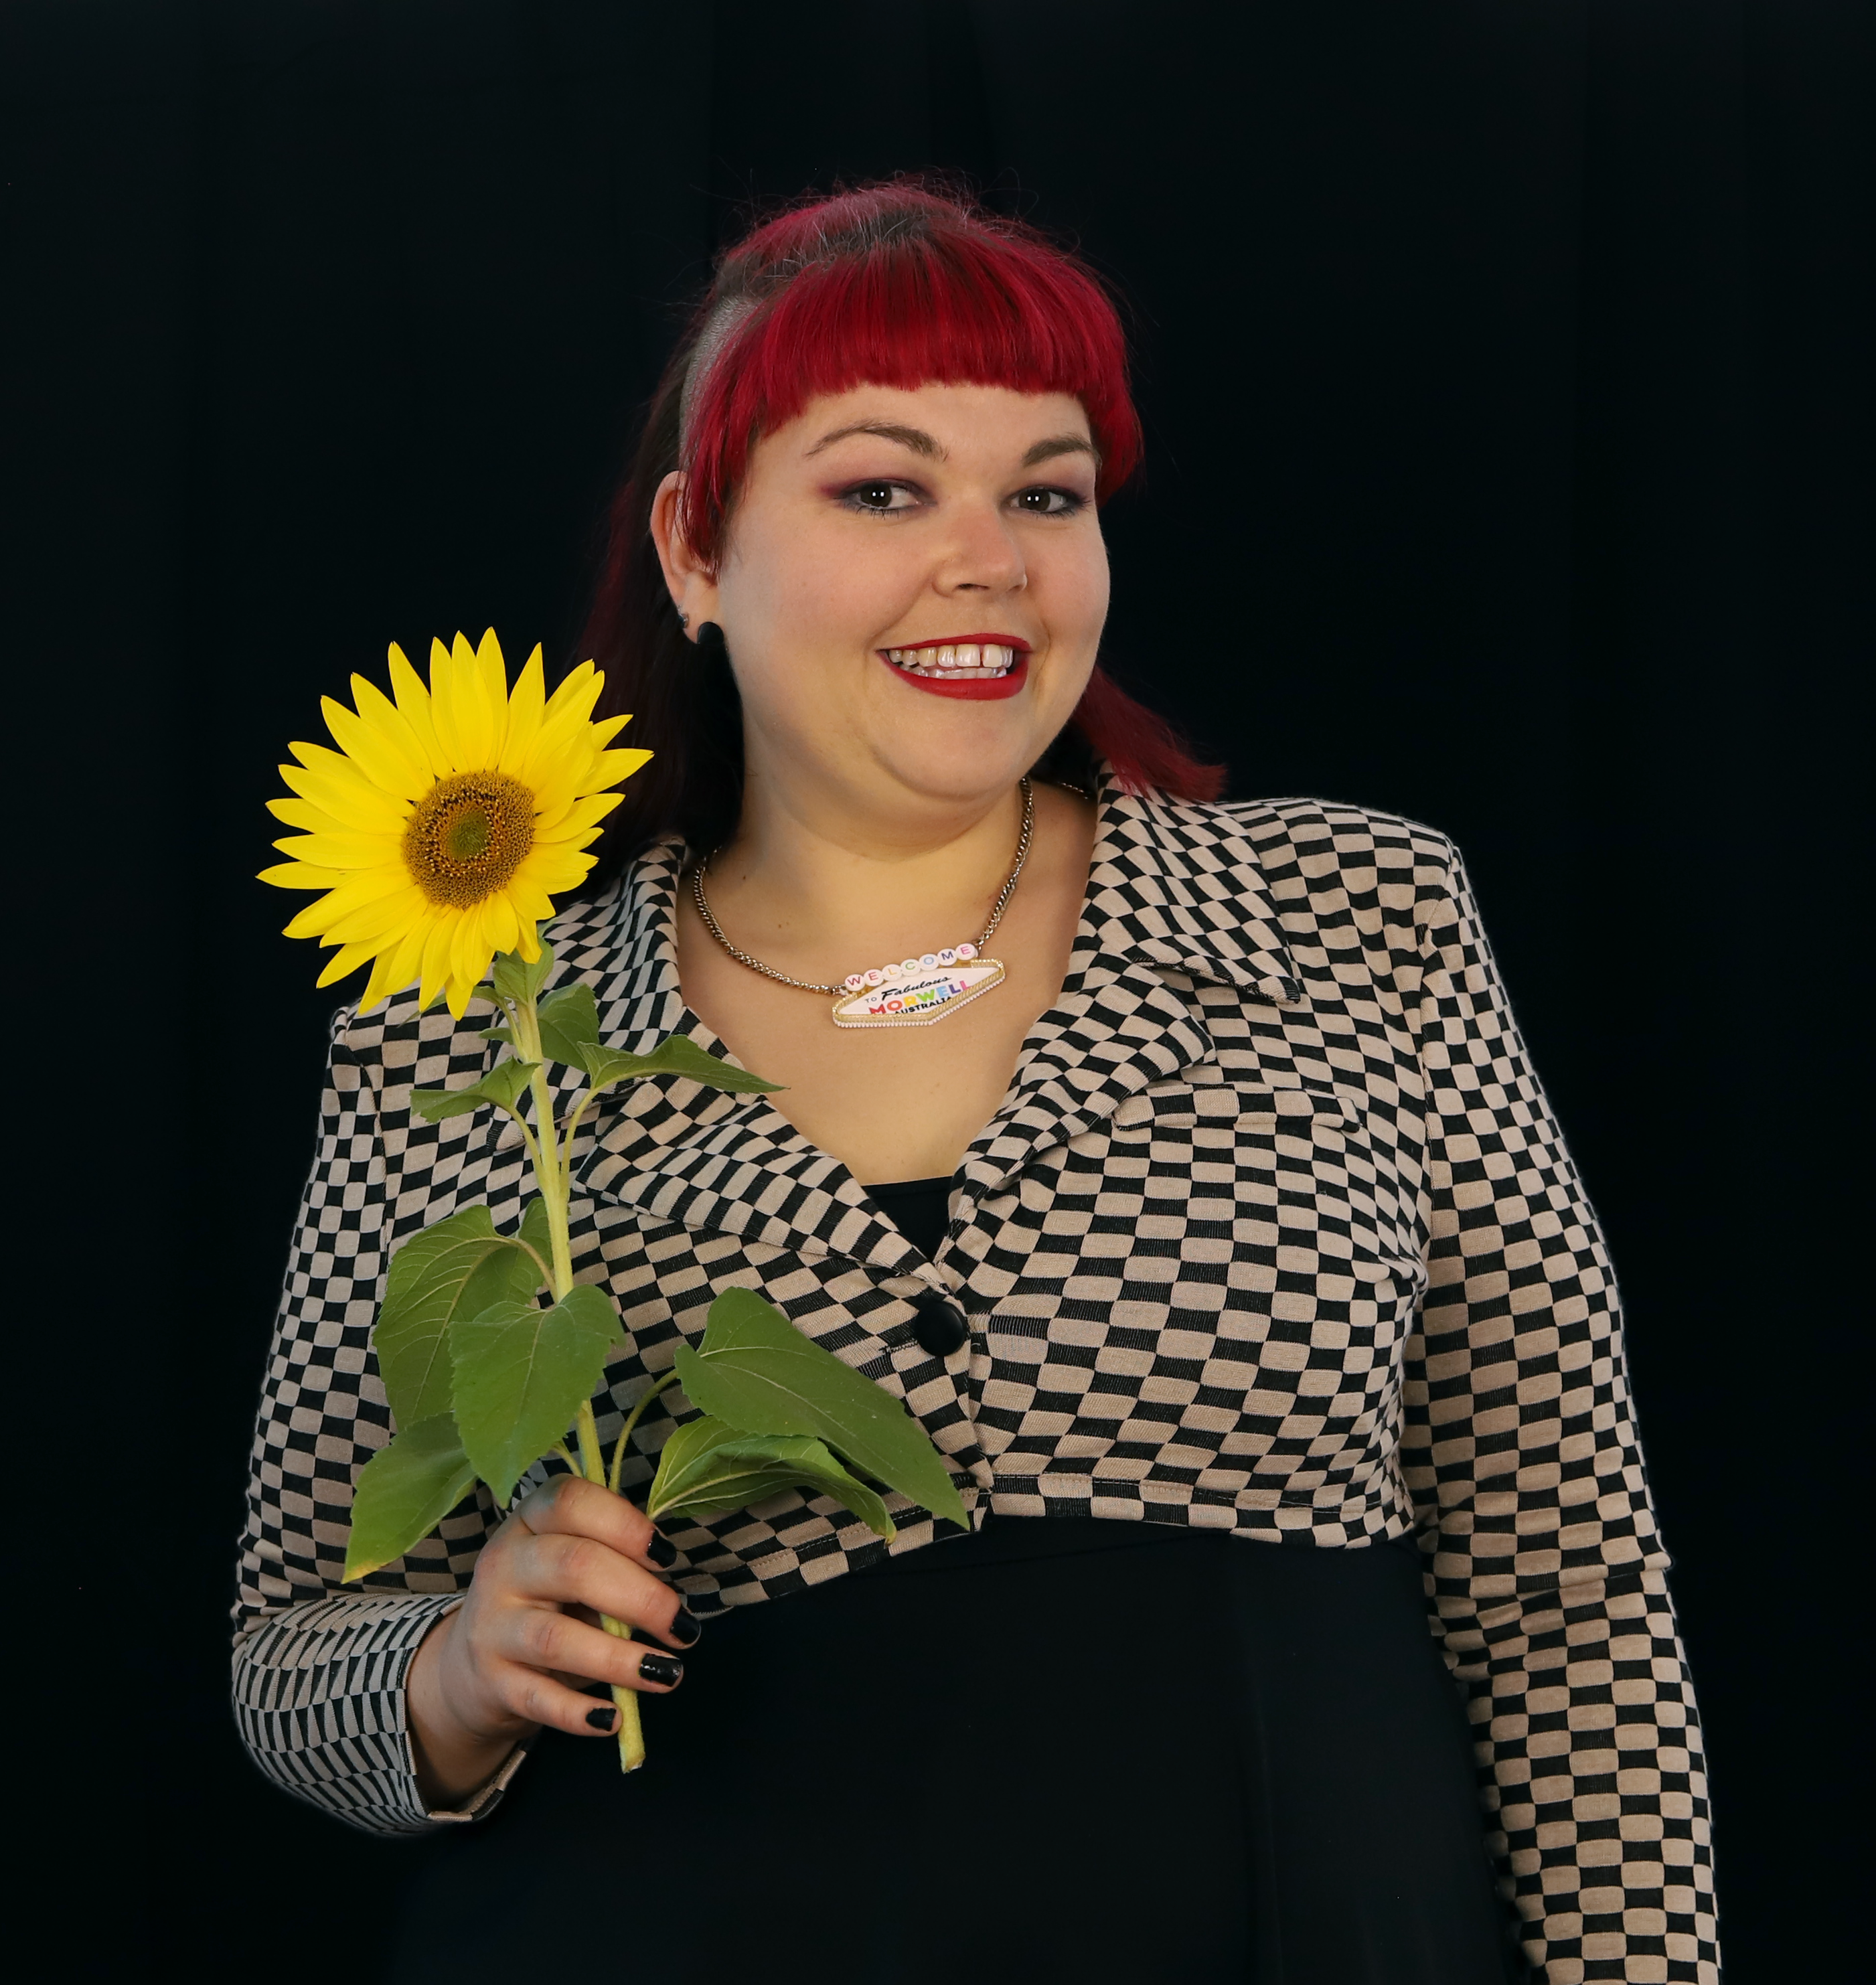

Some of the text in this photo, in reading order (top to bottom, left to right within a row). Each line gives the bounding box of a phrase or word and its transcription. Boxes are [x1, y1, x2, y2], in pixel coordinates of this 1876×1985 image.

[847, 946, 971, 986] WELCOME
[868, 980, 971, 1014] MORWELL
[881, 975, 952, 1002] Fabulous
